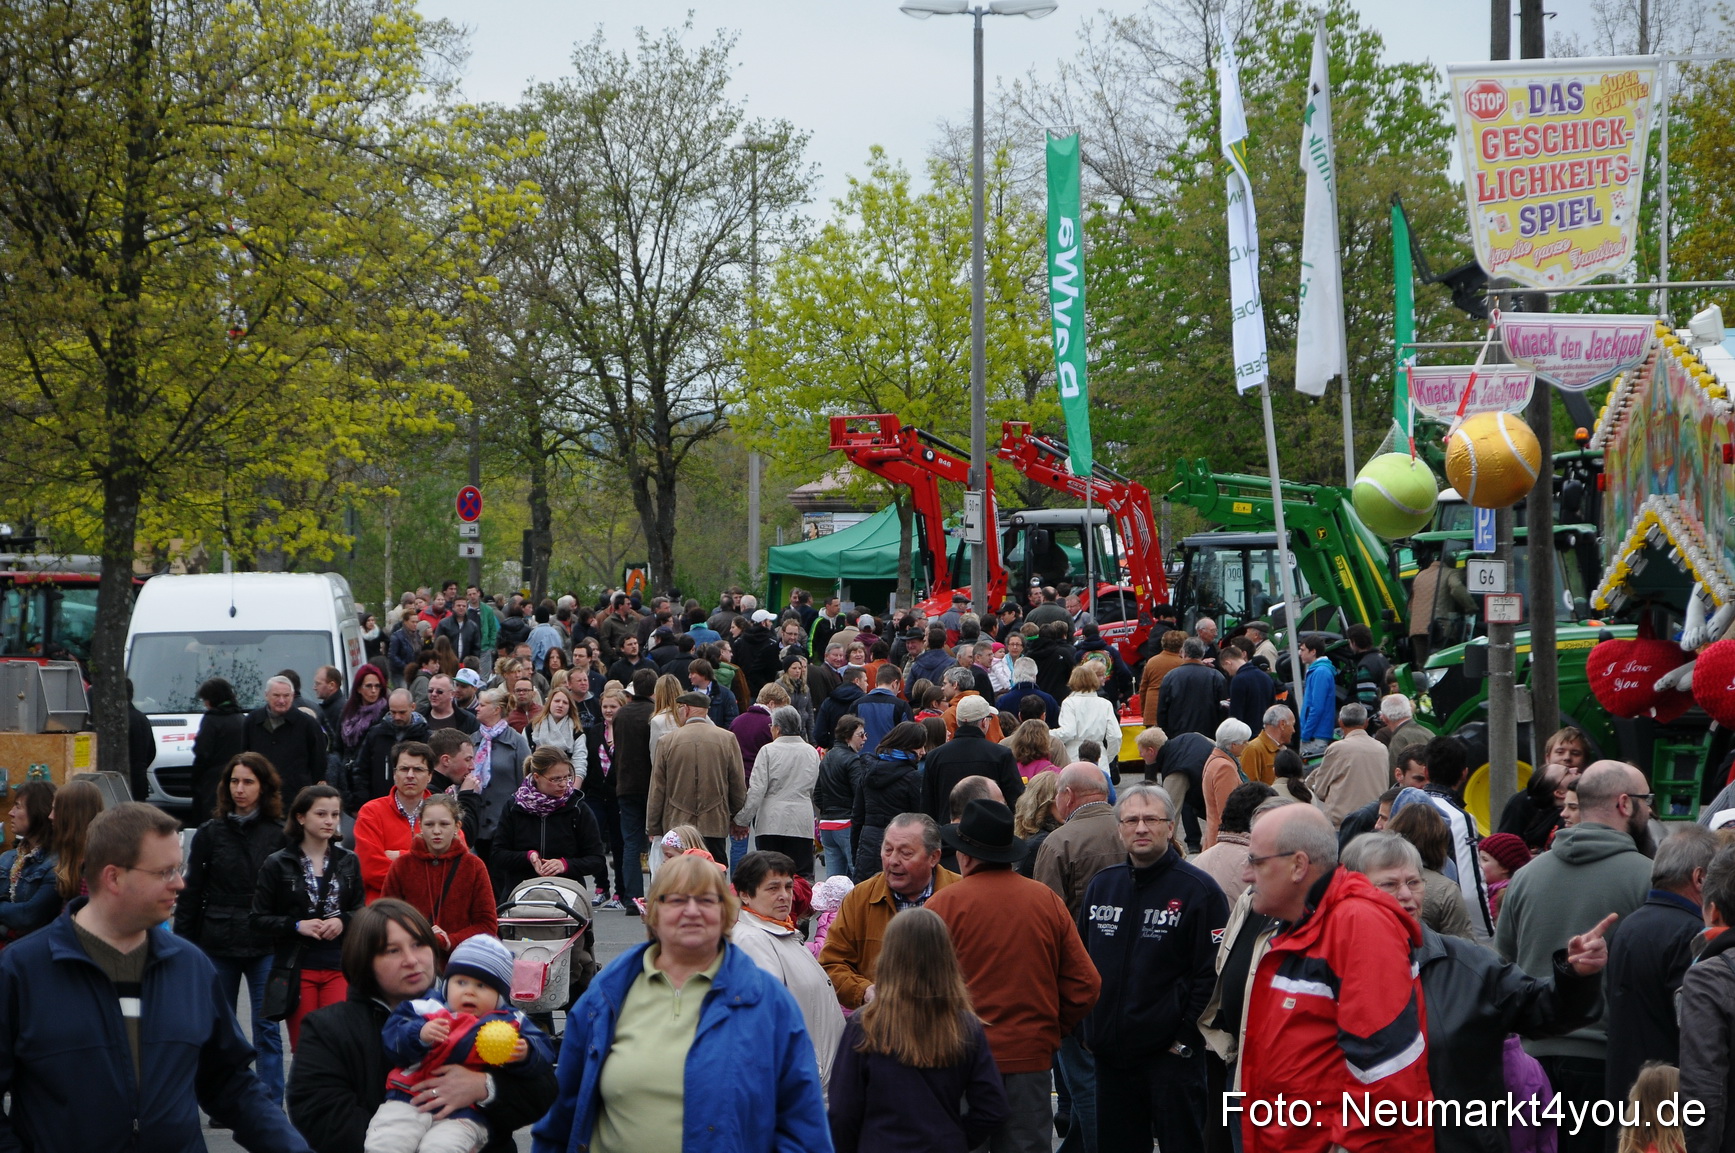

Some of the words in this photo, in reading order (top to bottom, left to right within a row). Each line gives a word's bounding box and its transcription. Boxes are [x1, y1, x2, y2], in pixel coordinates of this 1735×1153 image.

[1600, 70, 1640, 95] SUPER
[1470, 88, 1504, 111] STOP
[1528, 82, 1584, 116] DAS
[1481, 117, 1635, 162] GESCHICK-
[1476, 154, 1640, 204] LICHKEITS-
[1520, 195, 1603, 238] SPIEL
[1510, 324, 1559, 358] Knack
[1561, 335, 1583, 360] den
[1585, 326, 1648, 366] Jackpot
[1415, 377, 1457, 406] Knack
[1479, 569, 1495, 585] G6
[1602, 661, 1617, 677] I
[1622, 660, 1653, 673] Love
[1614, 678, 1640, 692] You
[1089, 905, 1123, 922] SCOT
